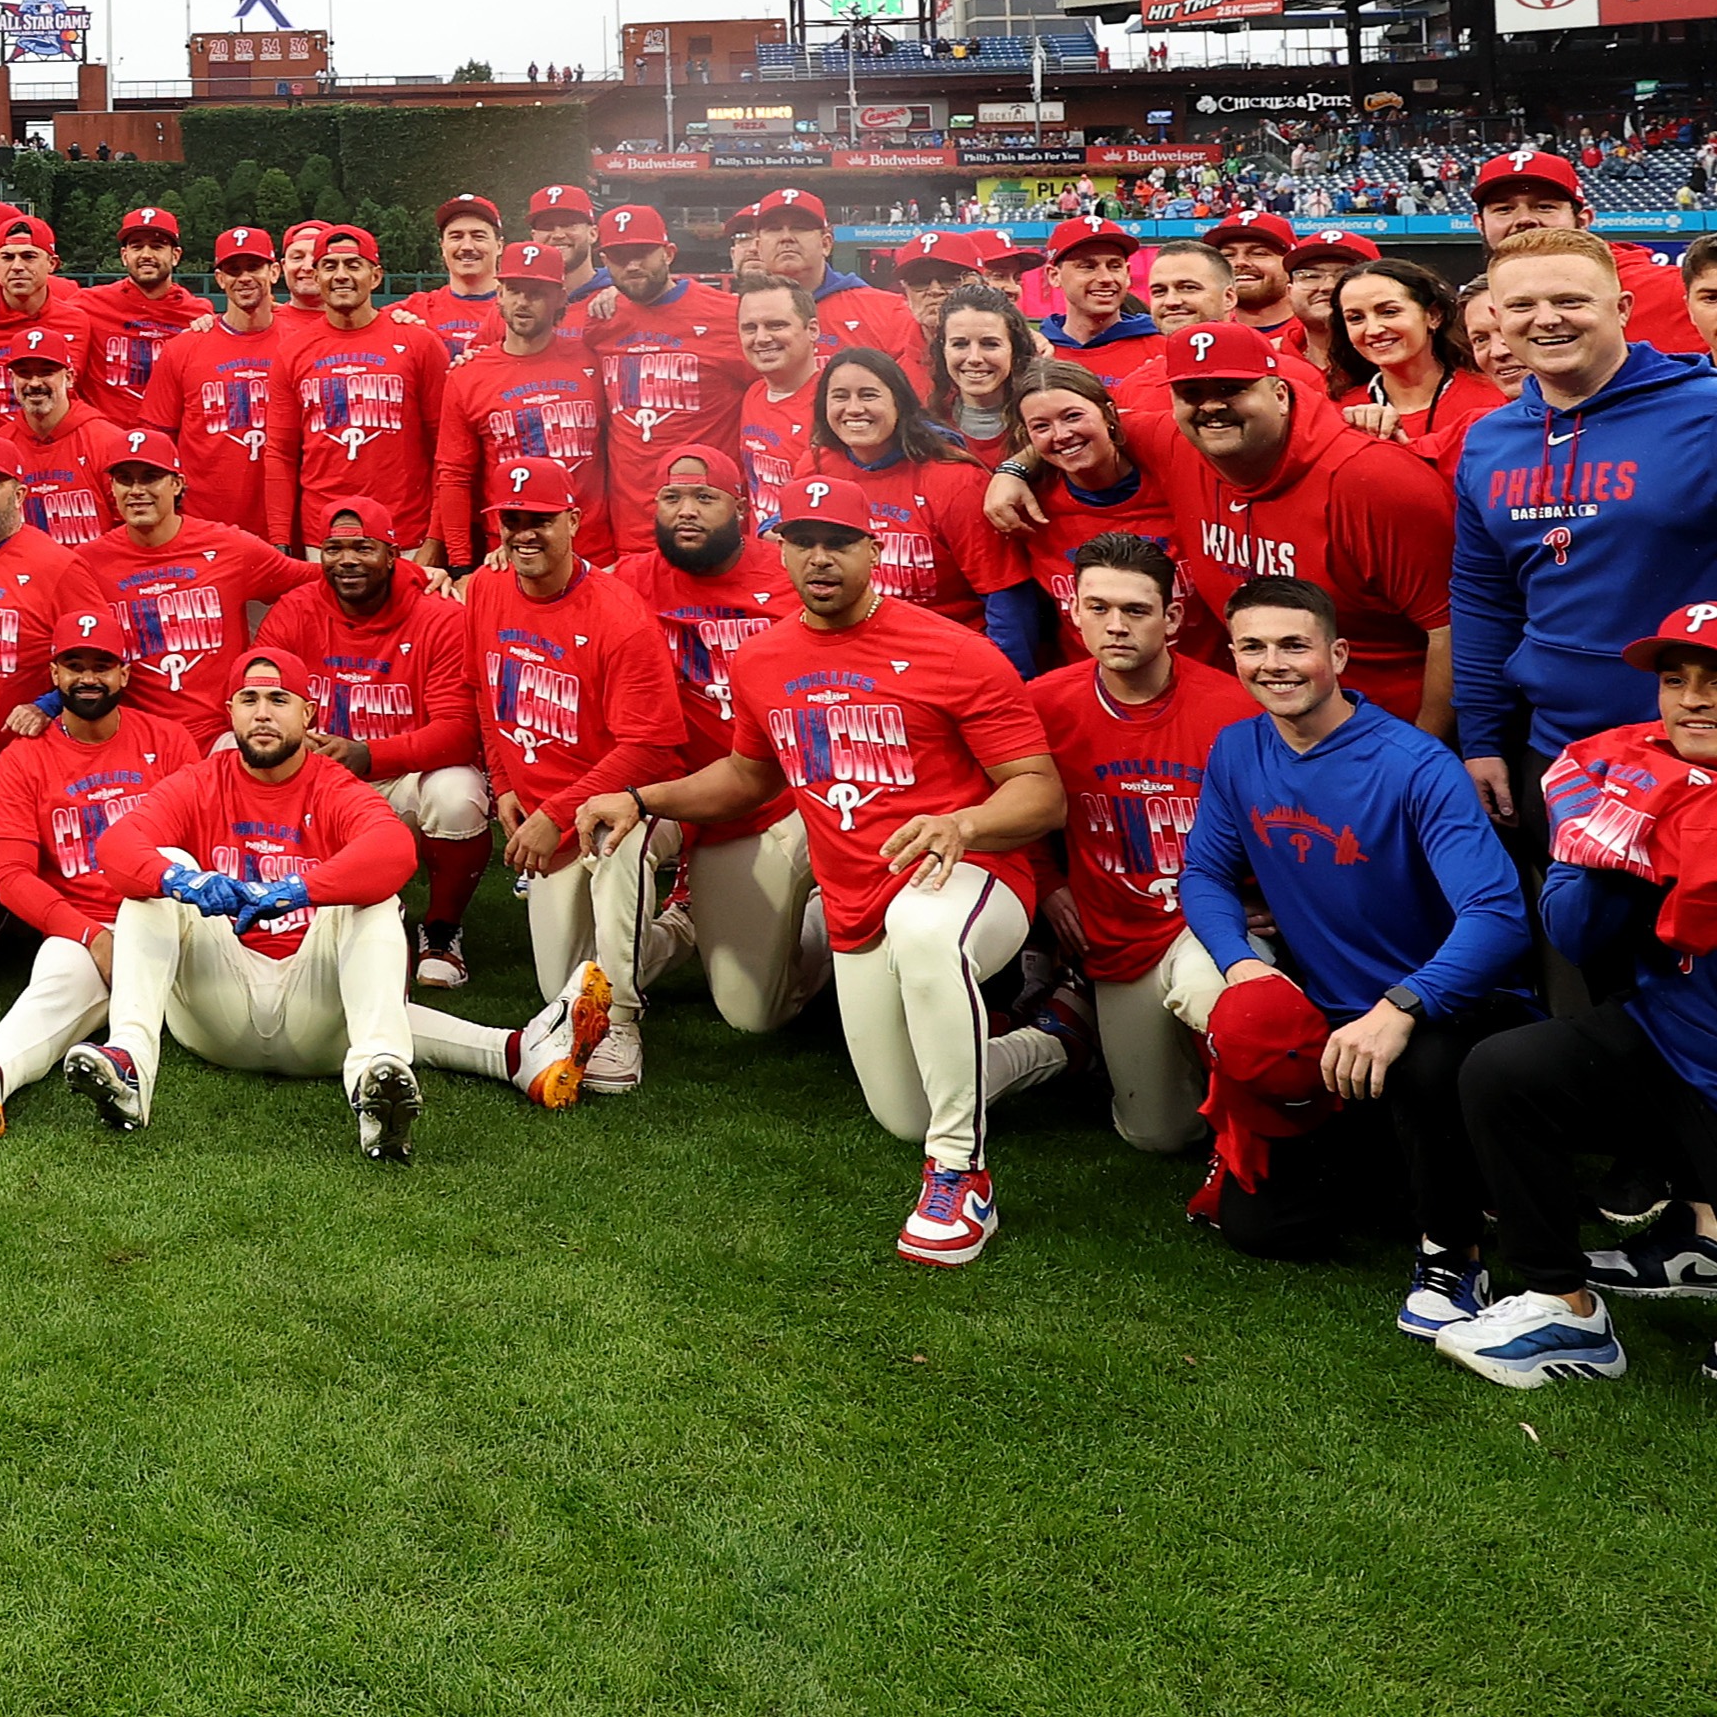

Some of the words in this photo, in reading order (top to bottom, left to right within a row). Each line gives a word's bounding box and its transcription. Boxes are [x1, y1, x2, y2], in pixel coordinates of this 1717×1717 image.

[1148, 2, 1179, 20] HIT
[1215, 4, 1242, 17] 25K
[23, 14, 54, 30] STAR
[55, 13, 90, 30] GAME
[210, 39, 228, 55] 20
[235, 38, 253, 54] 32
[261, 38, 280, 54] 34
[290, 37, 309, 53] 36
[994, 152, 1016, 161] This
[1044, 152, 1060, 161] For
[1062, 152, 1080, 160] You
[1294, 218, 1373, 233] Independence
[1592, 215, 1664, 231] pendence
[1489, 460, 1638, 509] PHILLIES
[1511, 504, 1577, 521] BASEBALL
[1543, 526, 1573, 566] P
[784, 670, 877, 696] PHILLIES
[1094, 759, 1204, 784] PHILLIES
[1289, 833, 1313, 864] P
